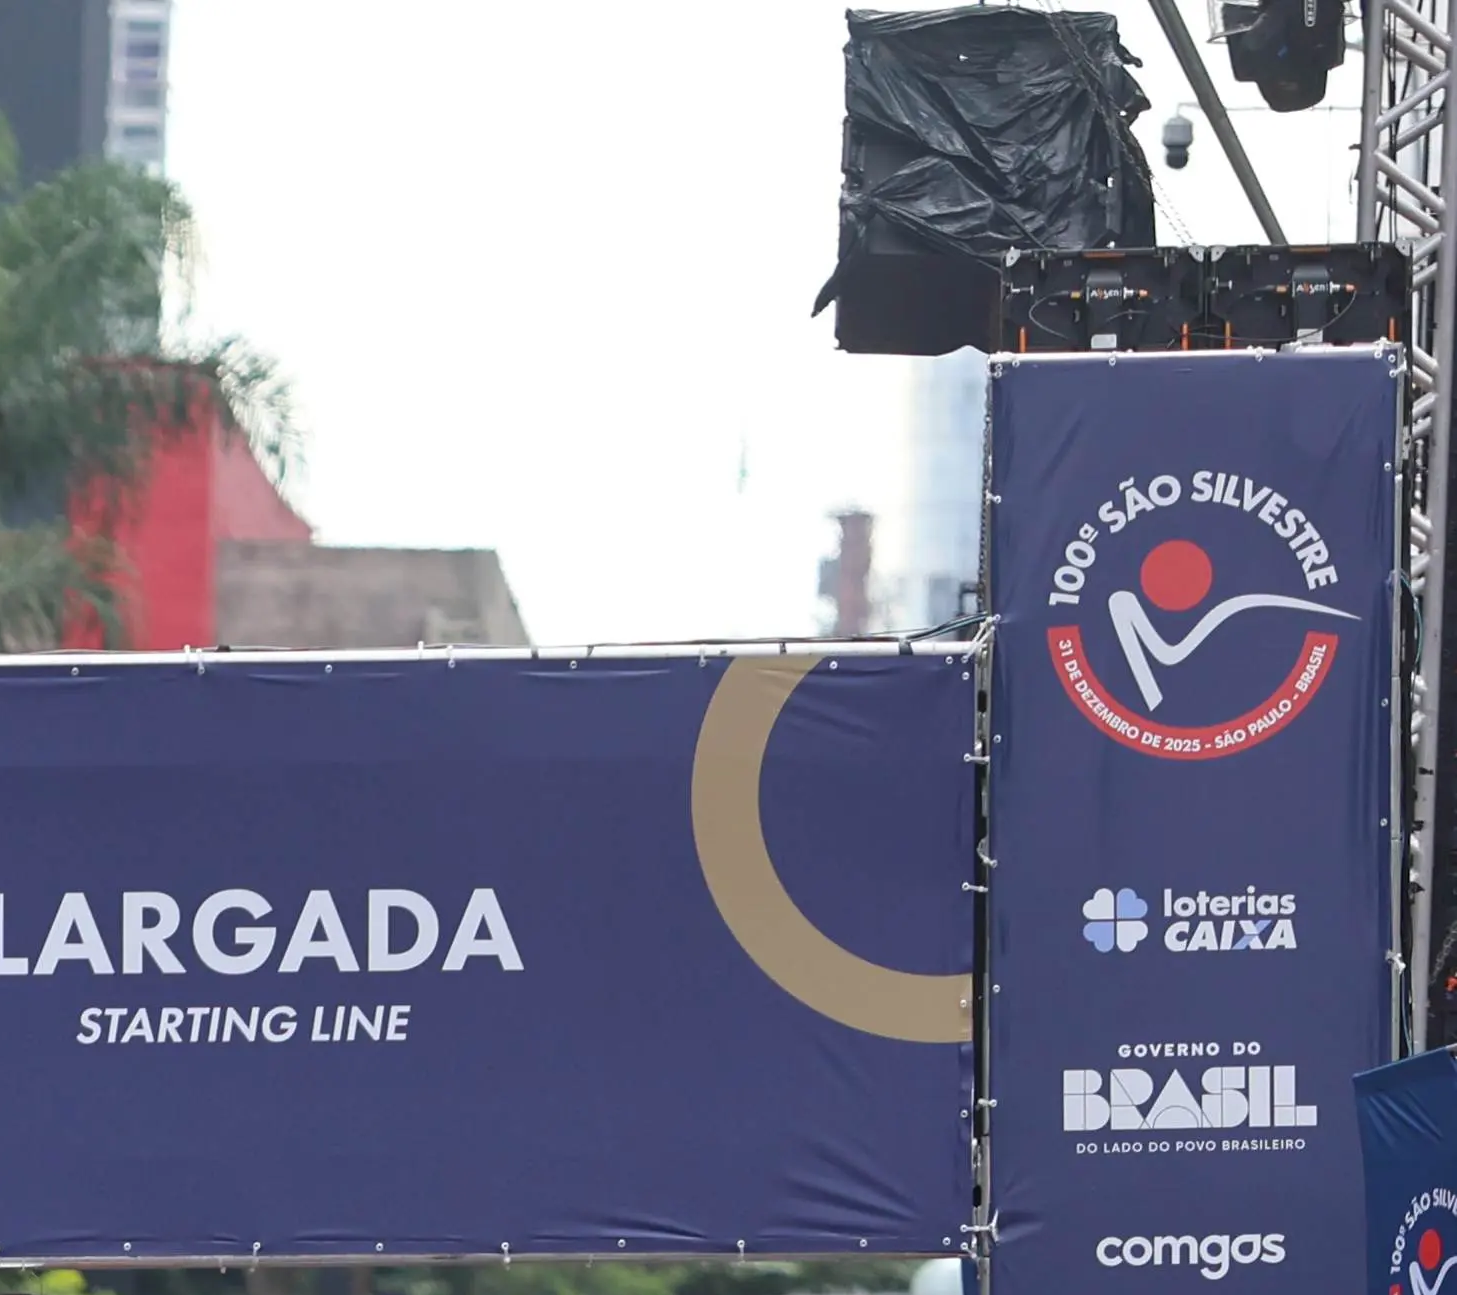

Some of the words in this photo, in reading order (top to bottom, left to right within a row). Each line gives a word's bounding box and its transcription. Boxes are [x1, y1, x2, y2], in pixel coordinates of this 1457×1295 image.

[1049, 522, 1099, 606] 100ª
[1098, 474, 1182, 534] SÃO
[1190, 470, 1339, 591] SILVESTRE
[1163, 886, 1296, 917] loterias
[1163, 919, 1297, 952] CAIXA
[75, 1005, 297, 1045] STARTING
[310, 1004, 411, 1043] LINE
[1118, 1042, 1220, 1058] GOVERNO
[1233, 1042, 1261, 1056] DO
[1063, 1065, 1318, 1131] BRASIL
[1077, 1142, 1098, 1154] DO
[1104, 1142, 1143, 1153] LADO
[1149, 1141, 1170, 1153] DO
[1176, 1140, 1216, 1152] POVO
[1222, 1138, 1306, 1151] BRASILEIRO
[1096, 1232, 1287, 1281] comgas
